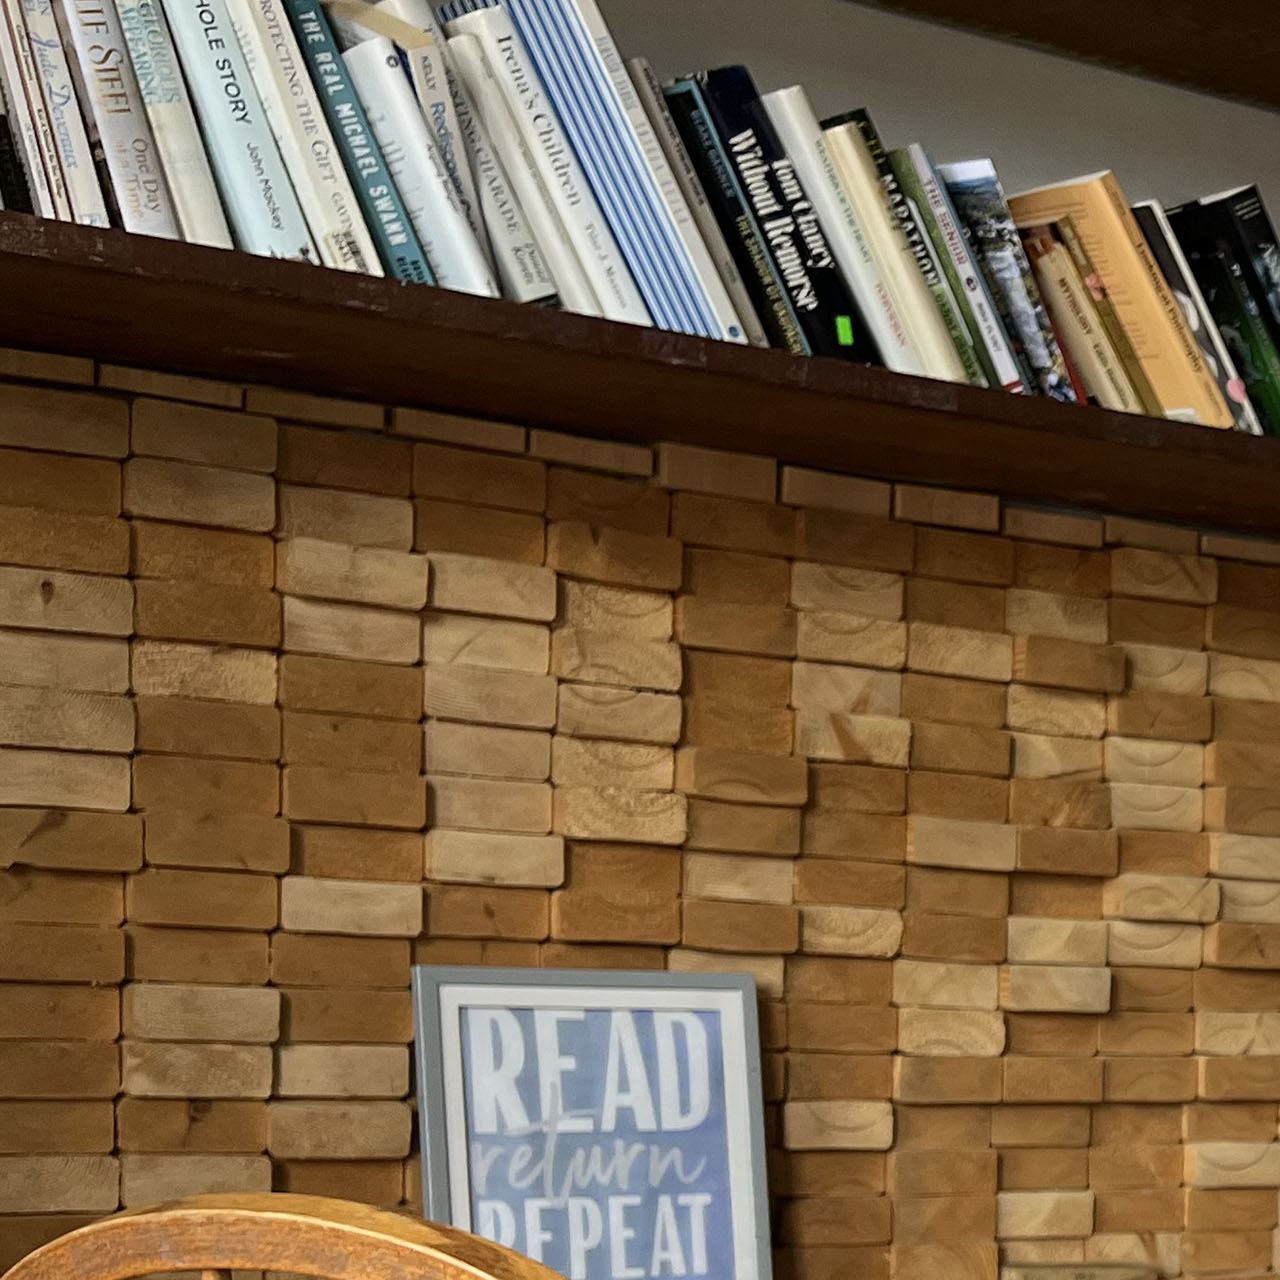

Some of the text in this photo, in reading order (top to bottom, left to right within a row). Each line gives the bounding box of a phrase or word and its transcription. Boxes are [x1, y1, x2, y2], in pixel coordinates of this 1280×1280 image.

[88, 45, 131, 113] STEEL
[140, 2, 181, 103] GLORIOUS
[216, 58, 252, 125] STORY
[421, 55, 437, 91] KELLY
[29, 32, 60, 79] Jude
[46, 84, 77, 168] Deveraux
[297, 99, 318, 136] THE
[300, 11, 408, 246] THE REAL MICHAEL SWANN
[497, 35, 582, 207] Irena's Children
[131, 138, 162, 213] One Day
[247, 142, 284, 232] John Mackey
[477, 150, 521, 234] CHARADE
[728, 128, 819, 312] Without Remorse
[771, 159, 835, 268] Tom Clancy
[924, 177, 969, 265] THE SENIOR
[1058, 277, 1092, 335] MYTHOLOGY
[467, 1008, 711, 1134] READ
[471, 1080, 707, 1209] return
